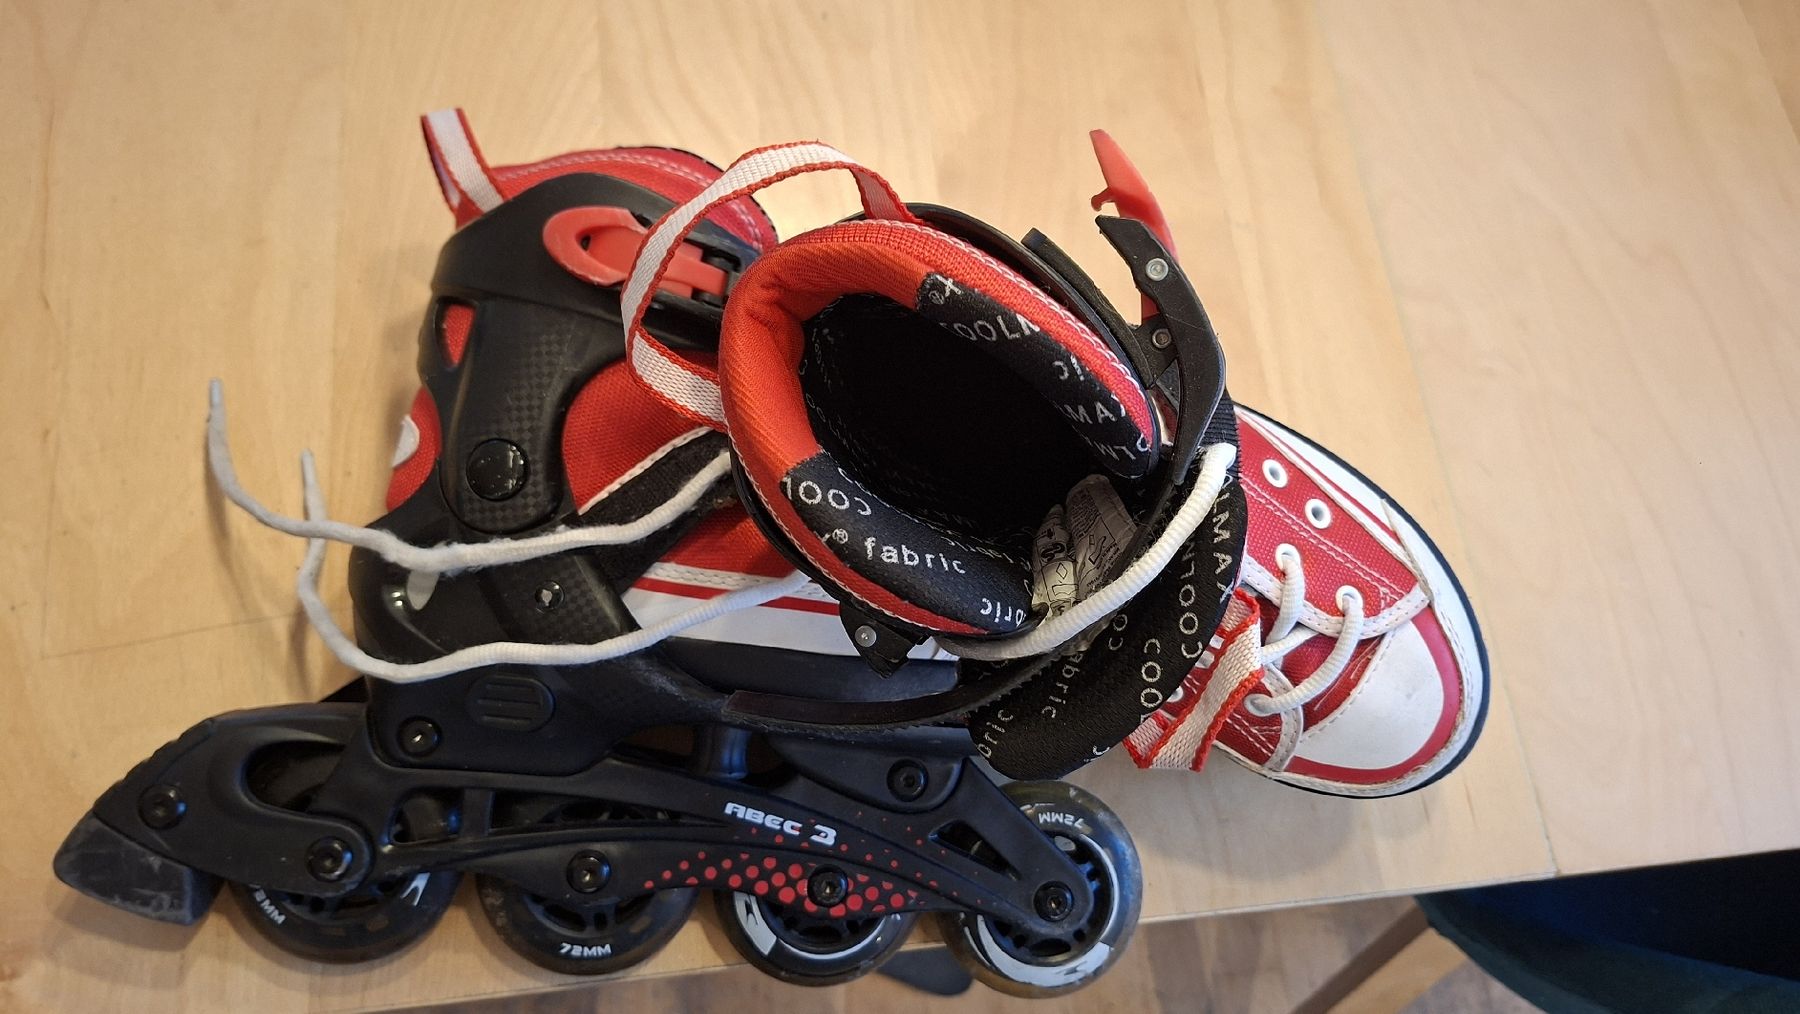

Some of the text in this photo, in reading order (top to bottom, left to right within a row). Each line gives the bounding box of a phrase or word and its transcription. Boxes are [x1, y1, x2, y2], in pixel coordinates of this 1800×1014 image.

[864, 536, 966, 574] fabric
[724, 802, 837, 846] ABEC 3
[560, 942, 612, 957] 72MM
